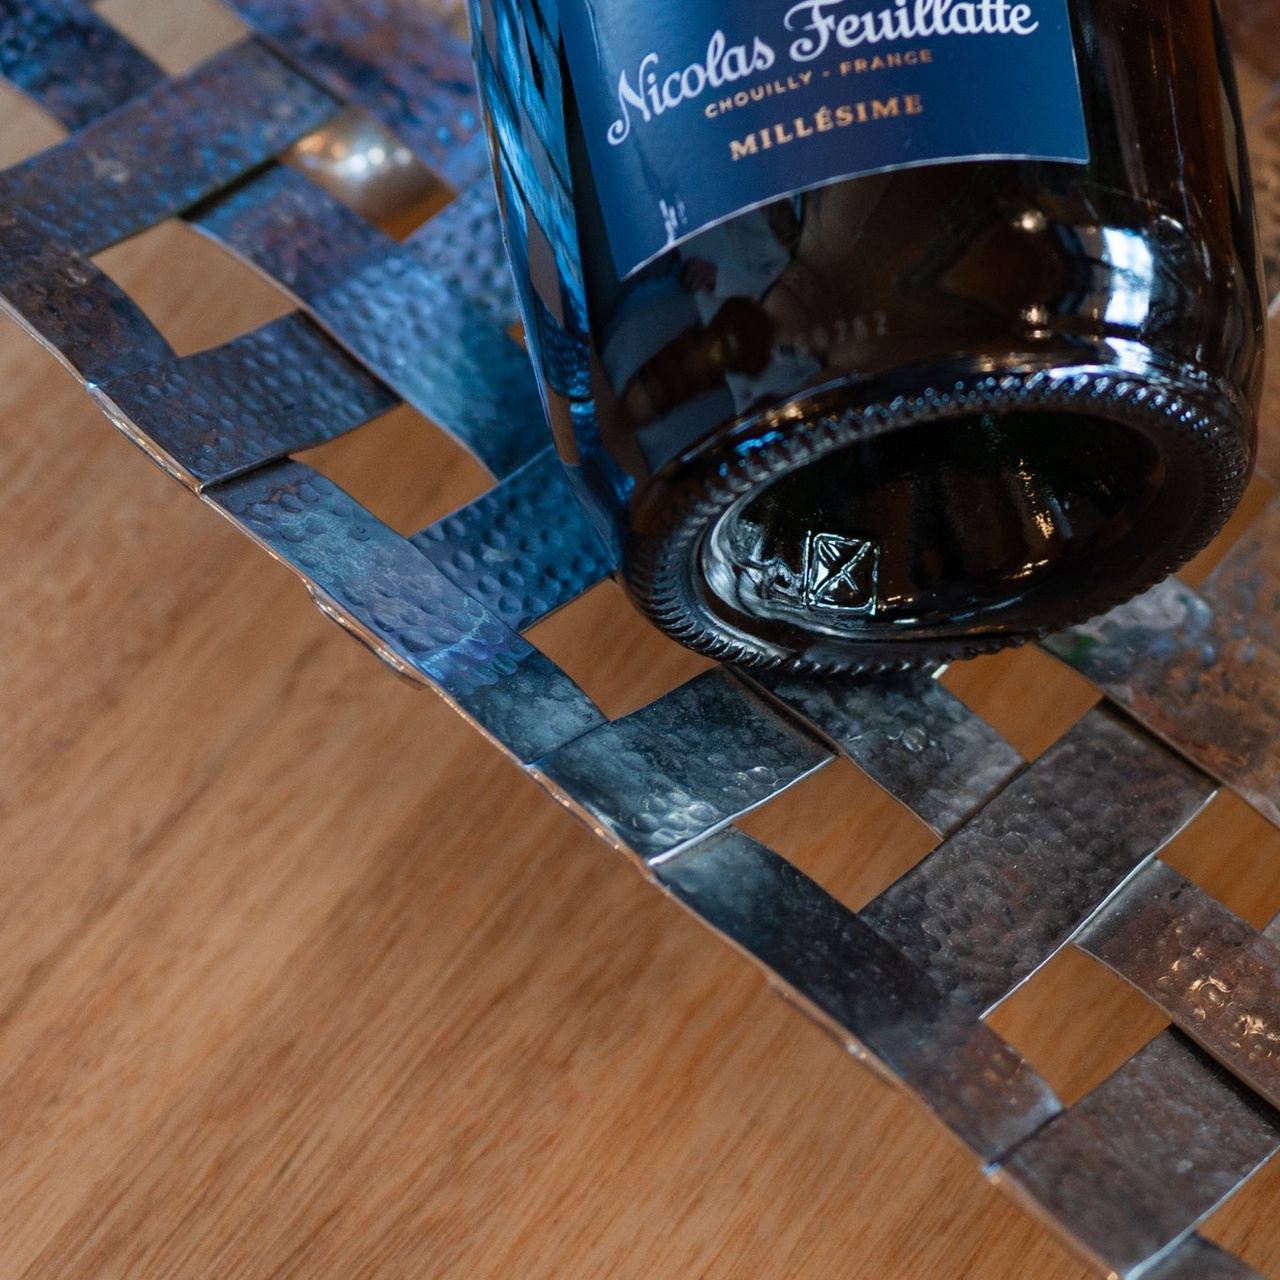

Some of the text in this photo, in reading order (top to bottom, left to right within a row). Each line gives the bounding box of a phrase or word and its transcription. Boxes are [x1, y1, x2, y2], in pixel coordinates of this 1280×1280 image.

[607, 29, 776, 146] Nicolas
[704, 70, 812, 119] CHOUILLY
[840, 49, 933, 76] FRANCE
[729, 94, 924, 160] MILLÉSIME
